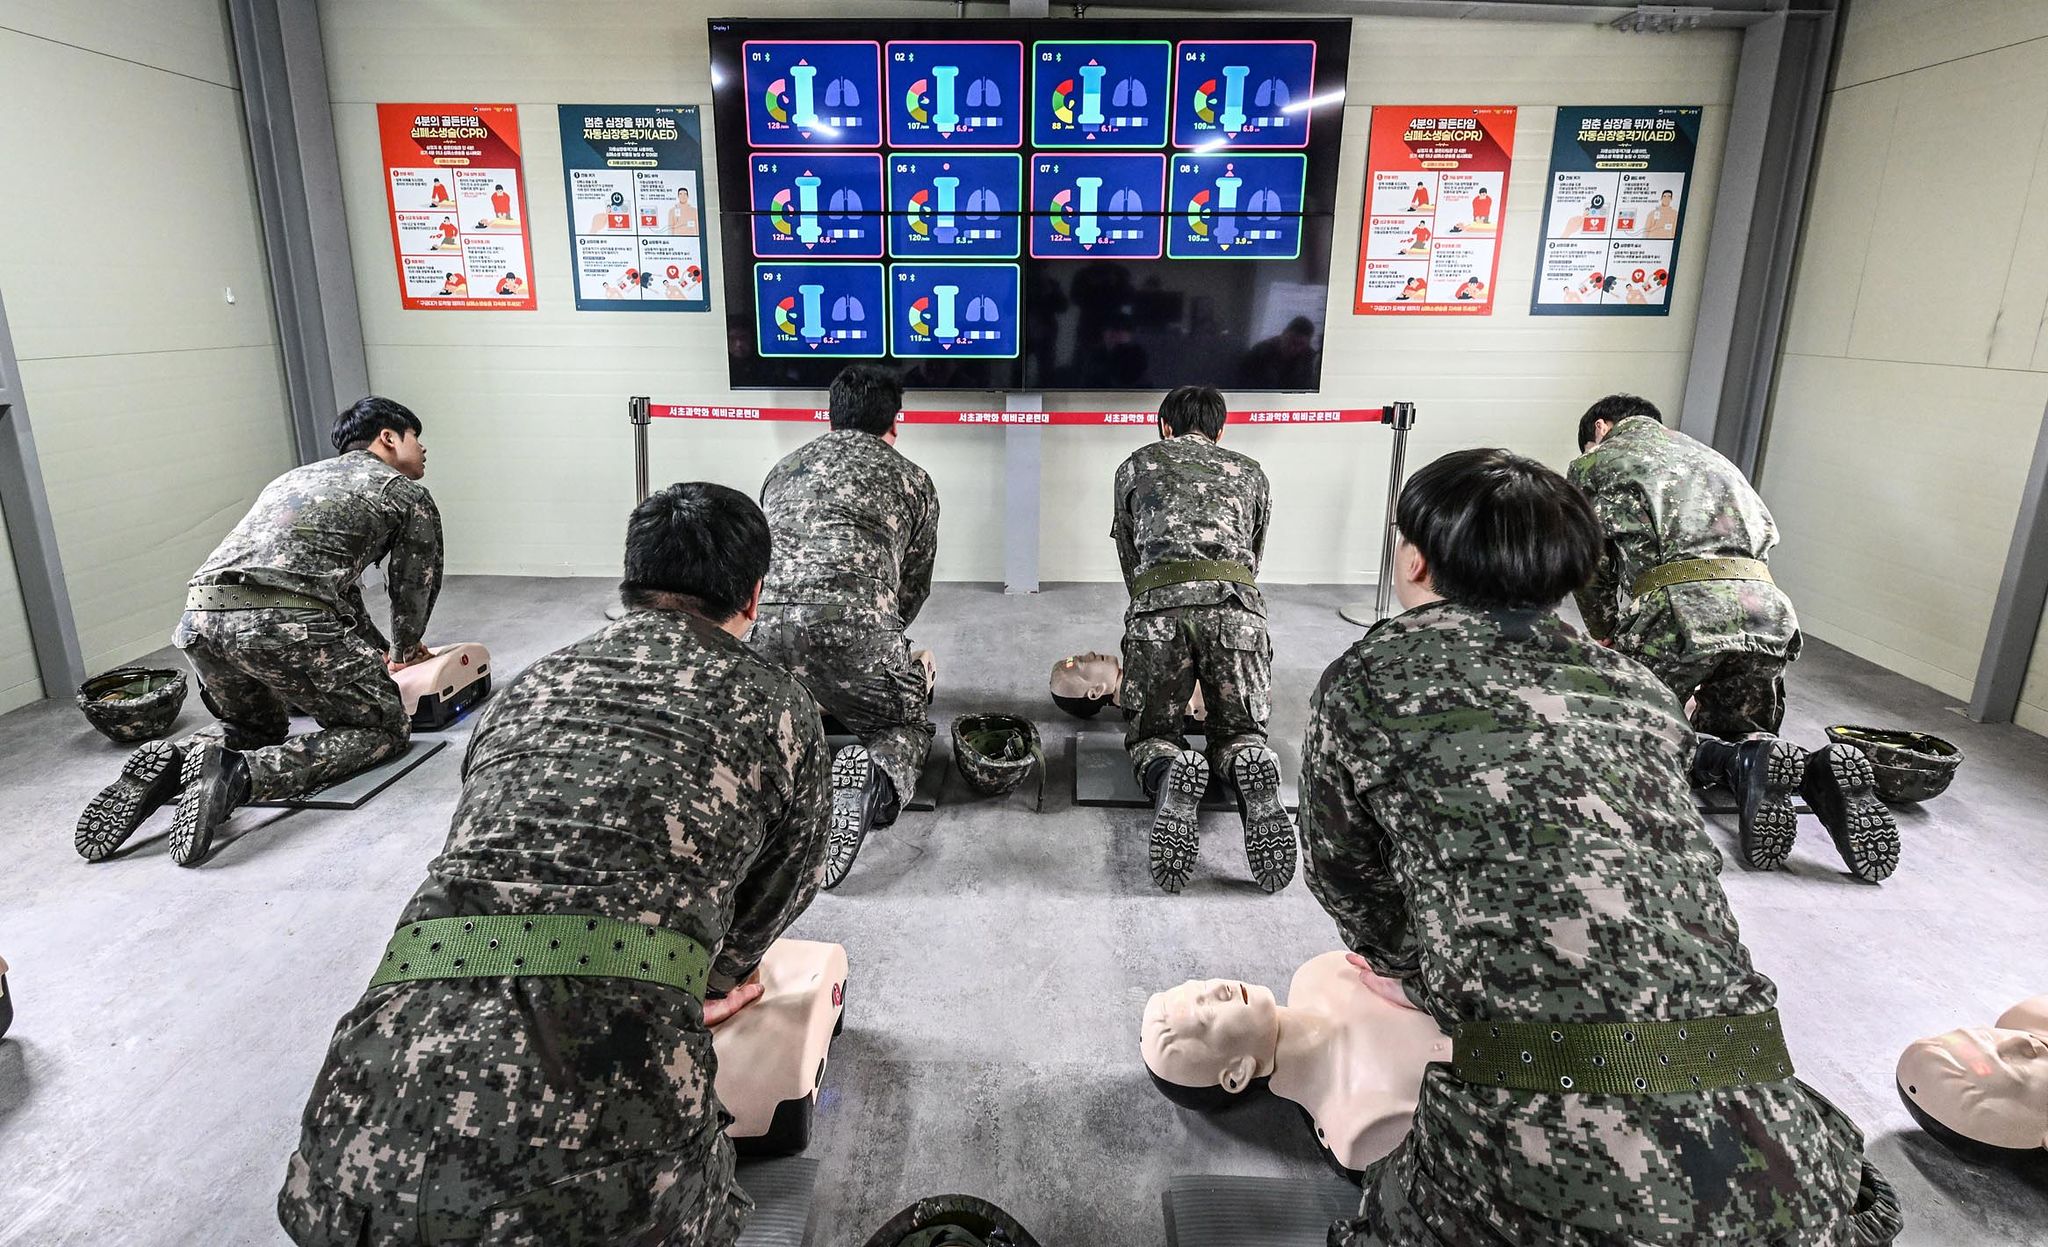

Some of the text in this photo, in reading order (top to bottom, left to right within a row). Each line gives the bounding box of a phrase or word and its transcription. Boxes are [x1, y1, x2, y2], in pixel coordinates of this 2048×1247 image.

[752, 52, 761, 61] 01
[895, 52, 905, 61] 02
[1042, 52, 1052, 61] 03
[1186, 52, 1196, 61] 04
[414, 115, 479, 127] 4분의 골든타임
[584, 117, 675, 128] 멈춘 심장을 뛰게 하는
[1409, 118, 1477, 130] 4분의 골든타임
[1581, 118, 1675, 130] 멈춘 심장을 뛰게 하는
[411, 127, 488, 139] 심폐소생술(CPR)
[583, 128, 678, 140] 자동심장충격기(AED)
[1403, 130, 1483, 141] 심폐소생술(CPR)
[1577, 130, 1676, 141] 자동심장충격기(AED)
[759, 164, 768, 172] 05
[897, 164, 907, 172] 06
[1040, 164, 1050, 173] 07
[1180, 164, 1190, 173] 08
[763, 273, 773, 281] 09
[898, 273, 907, 281] 10
[669, 407, 759, 418] 서초과학화 예비군훈련대
[959, 412, 1049, 423] 서초과학화 예비군훈련대
[1250, 411, 1340, 422] 서초과학화 예비군훈련대
[1104, 413, 1144, 423] 서초과학화
